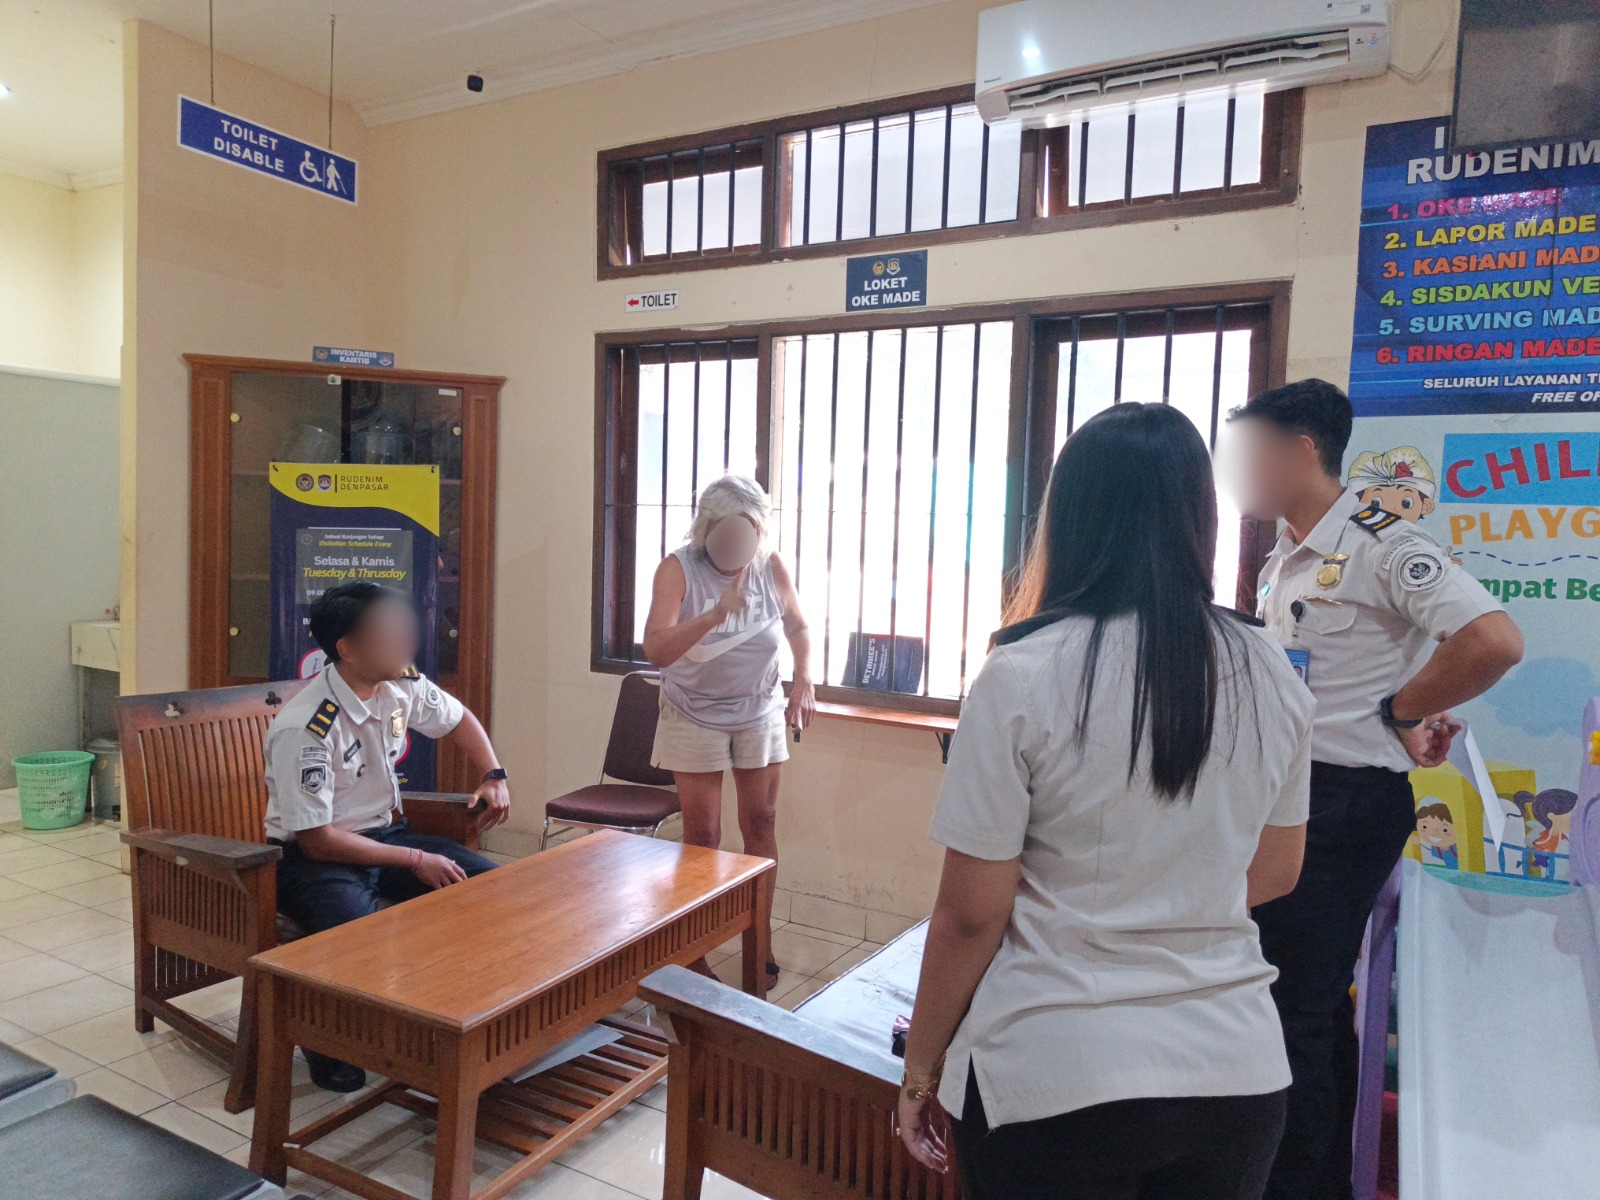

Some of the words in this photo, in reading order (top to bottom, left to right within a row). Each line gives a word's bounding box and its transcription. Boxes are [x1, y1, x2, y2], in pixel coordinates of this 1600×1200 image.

[221, 119, 279, 151] TOILET
[214, 137, 284, 173] DISABLE
[1407, 139, 1600, 184] RUDENIM
[1388, 203, 1409, 220] 1.
[1418, 196, 1473, 218] OKE
[1384, 233, 1407, 249] 2.
[1415, 223, 1505, 247] LAPOR
[1515, 214, 1597, 238] MADE
[1383, 261, 1405, 278] 3.
[1413, 251, 1526, 276] KASIANI
[863, 277, 907, 292] LOKET
[1380, 290, 1402, 307] 4.
[1411, 279, 1551, 305] SISDAKUN
[641, 293, 677, 308] TOILET
[851, 295, 879, 307] OKE
[882, 291, 920, 305] MADE
[1379, 319, 1401, 335] 5.
[1408, 311, 1533, 334] SURVING
[330, 348, 378, 359] INVENTARIS
[1376, 347, 1399, 364] 6.
[1407, 341, 1513, 363] RINGAN
[1522, 337, 1600, 358] MADE
[1423, 376, 1499, 389] SELURUH
[1504, 374, 1582, 387] LAYANAN
[1587, 373, 1600, 384] T
[1531, 391, 1577, 403] FREE
[340, 475, 383, 483] RUDENIM
[1446, 439, 1600, 498] CHIL
[340, 483, 389, 491] DENPASAR
[314, 555, 350, 566] Selasa
[351, 556, 360, 566] &
[361, 556, 395, 566] Kamis
[303, 567, 347, 580] Tuesday
[347, 568, 356, 578] &
[358, 568, 406, 580] Thrusday
[1478, 577, 1557, 603] mpat
